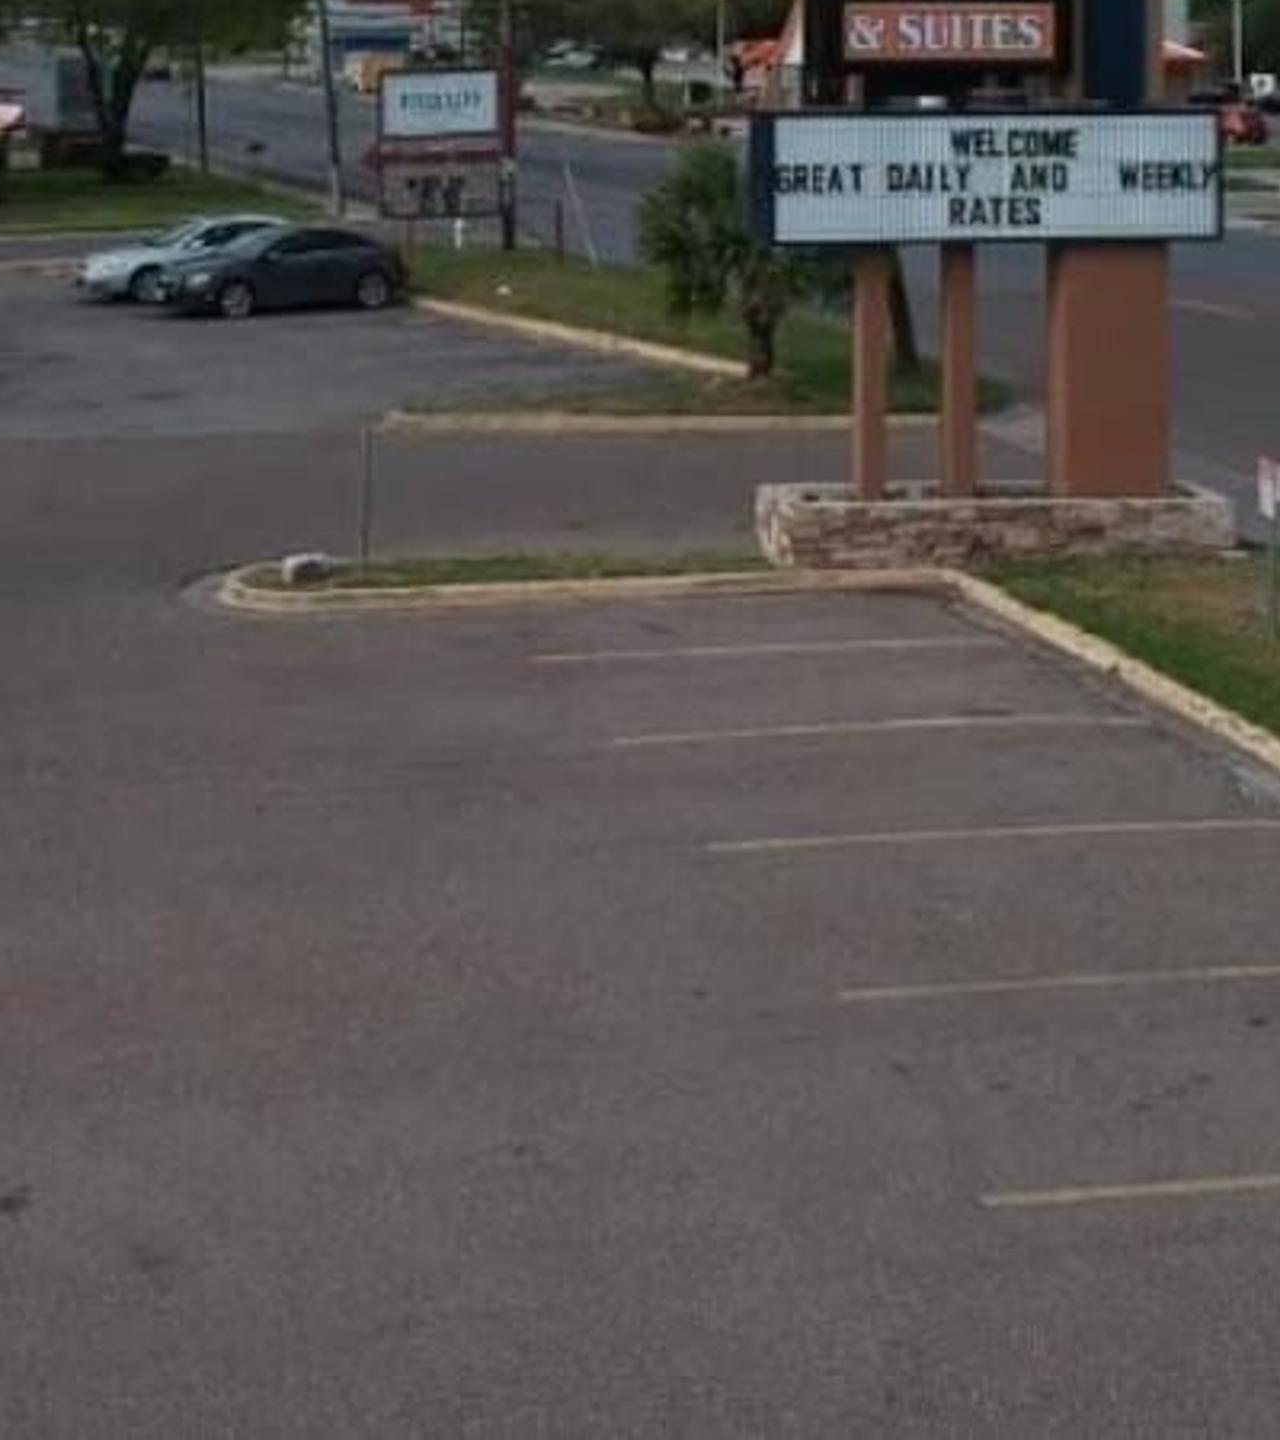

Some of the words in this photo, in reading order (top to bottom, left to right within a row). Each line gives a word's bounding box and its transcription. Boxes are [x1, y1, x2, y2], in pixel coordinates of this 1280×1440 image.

[848, 15, 884, 49] &
[898, 14, 1043, 49] SUITES
[949, 128, 1079, 159] WELCOME
[776, 163, 863, 195] GREAT
[886, 163, 971, 194] DAILY
[1010, 162, 1068, 193] AND
[1120, 161, 1218, 192] WEEKLY
[949, 197, 1042, 226] RATES
